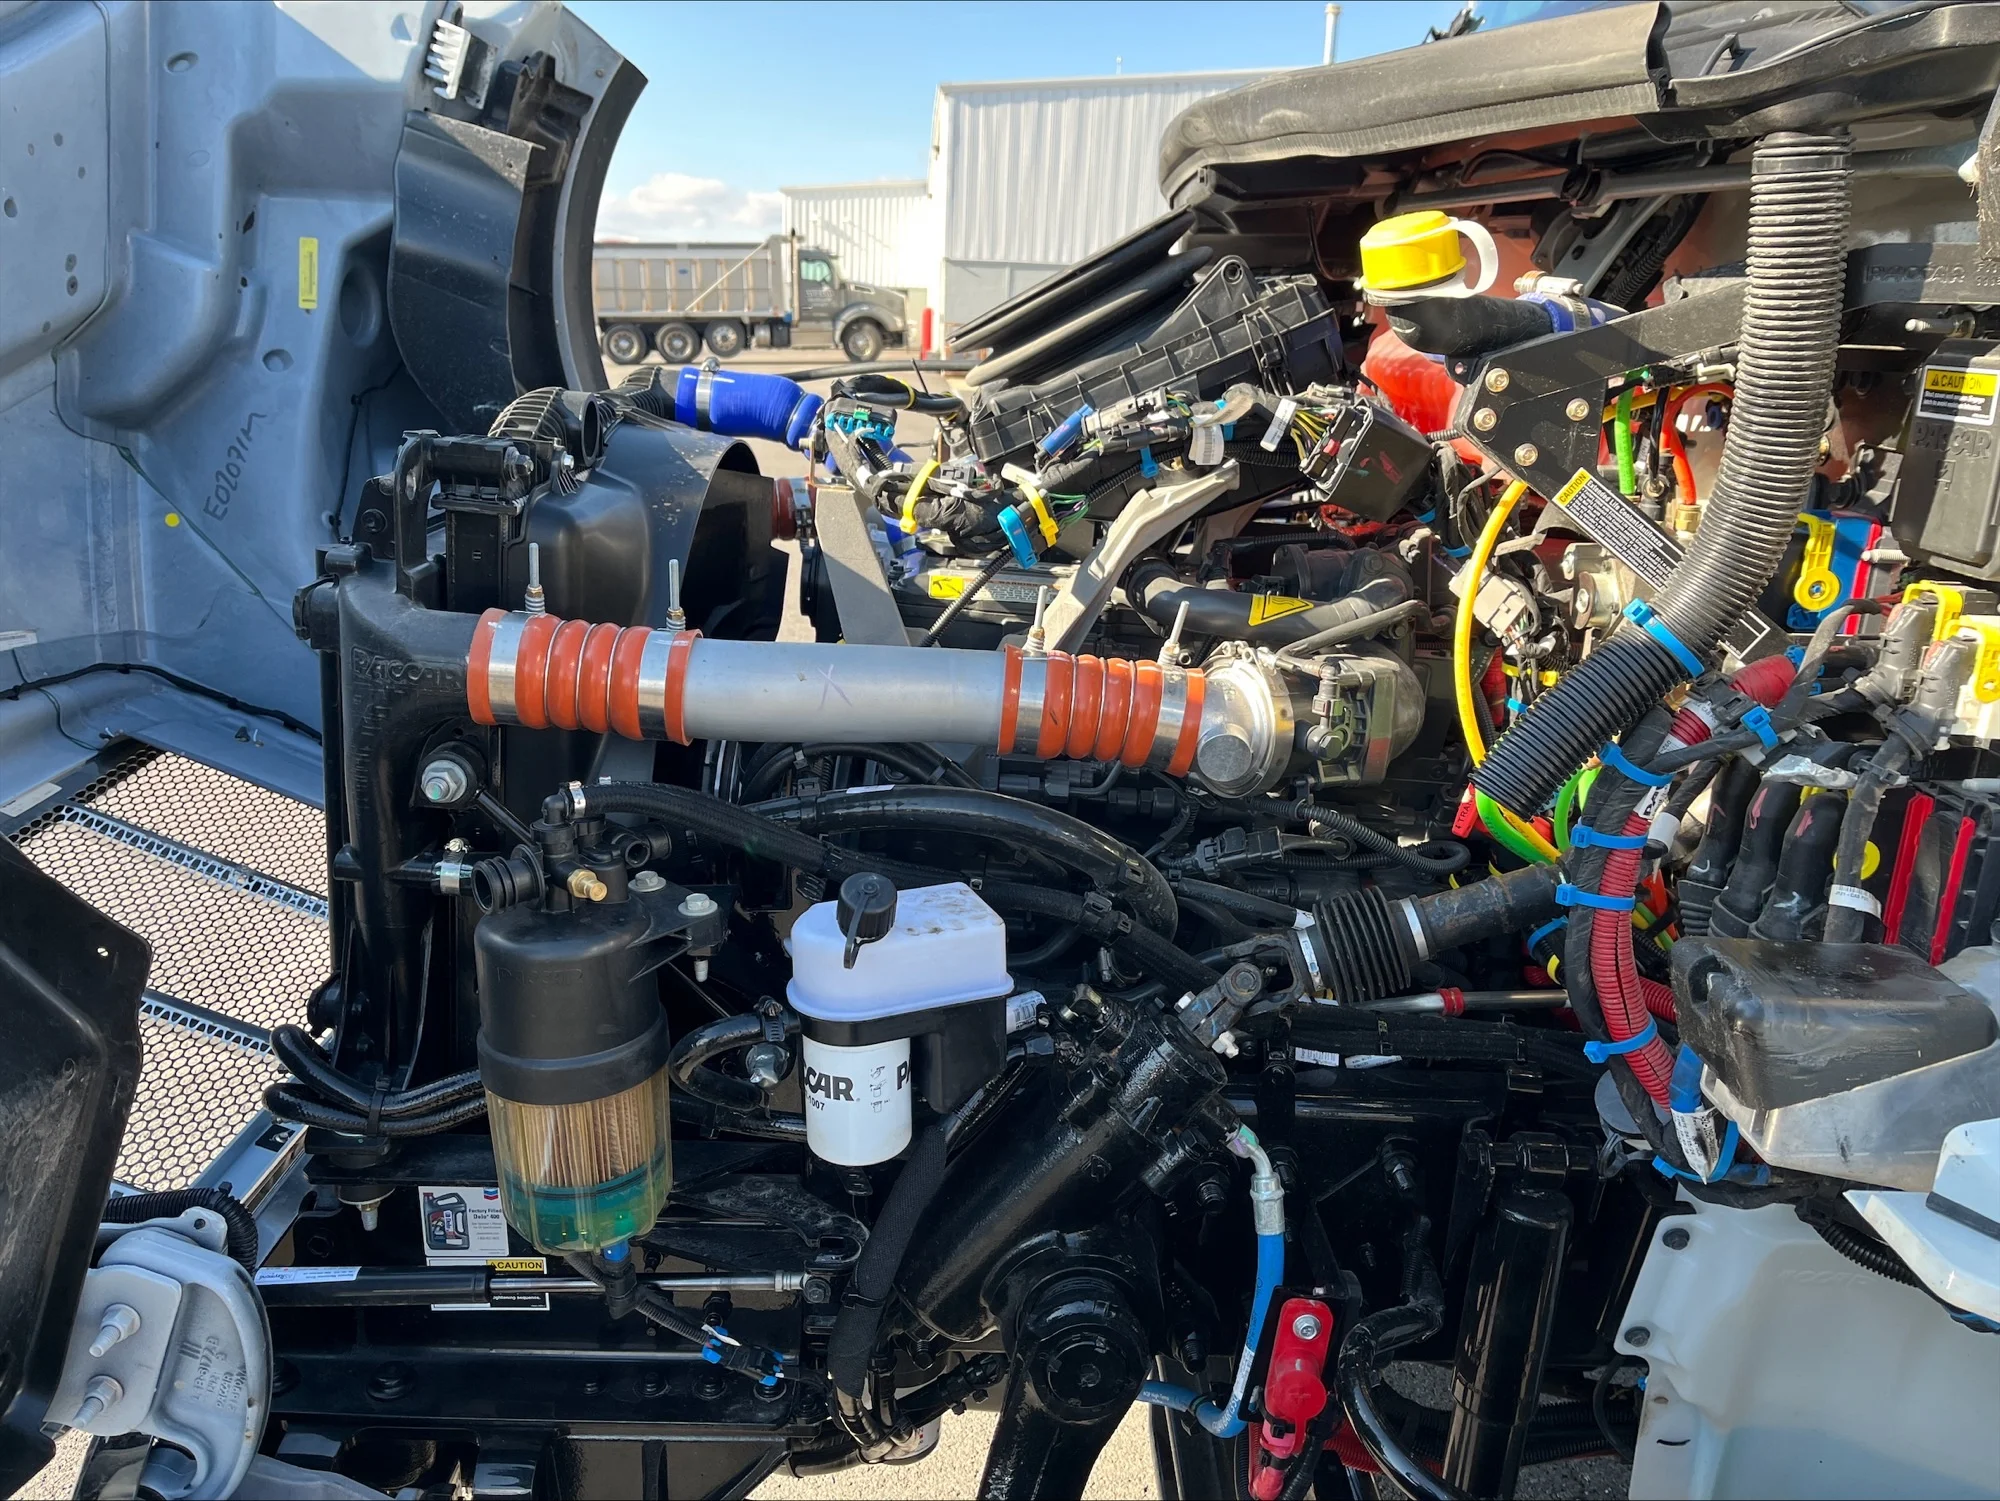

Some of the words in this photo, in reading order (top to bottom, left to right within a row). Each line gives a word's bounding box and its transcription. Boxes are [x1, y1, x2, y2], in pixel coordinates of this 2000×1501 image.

[1941, 374, 1983, 390] CAUTION
[1559, 473, 1587, 503] CAUTION
[1586, 479, 1611, 503] Extended
[1607, 498, 1621, 511] Life
[1618, 505, 1665, 548] Coolant/Antifreeze
[496, 1261, 542, 1269] CAUTION
